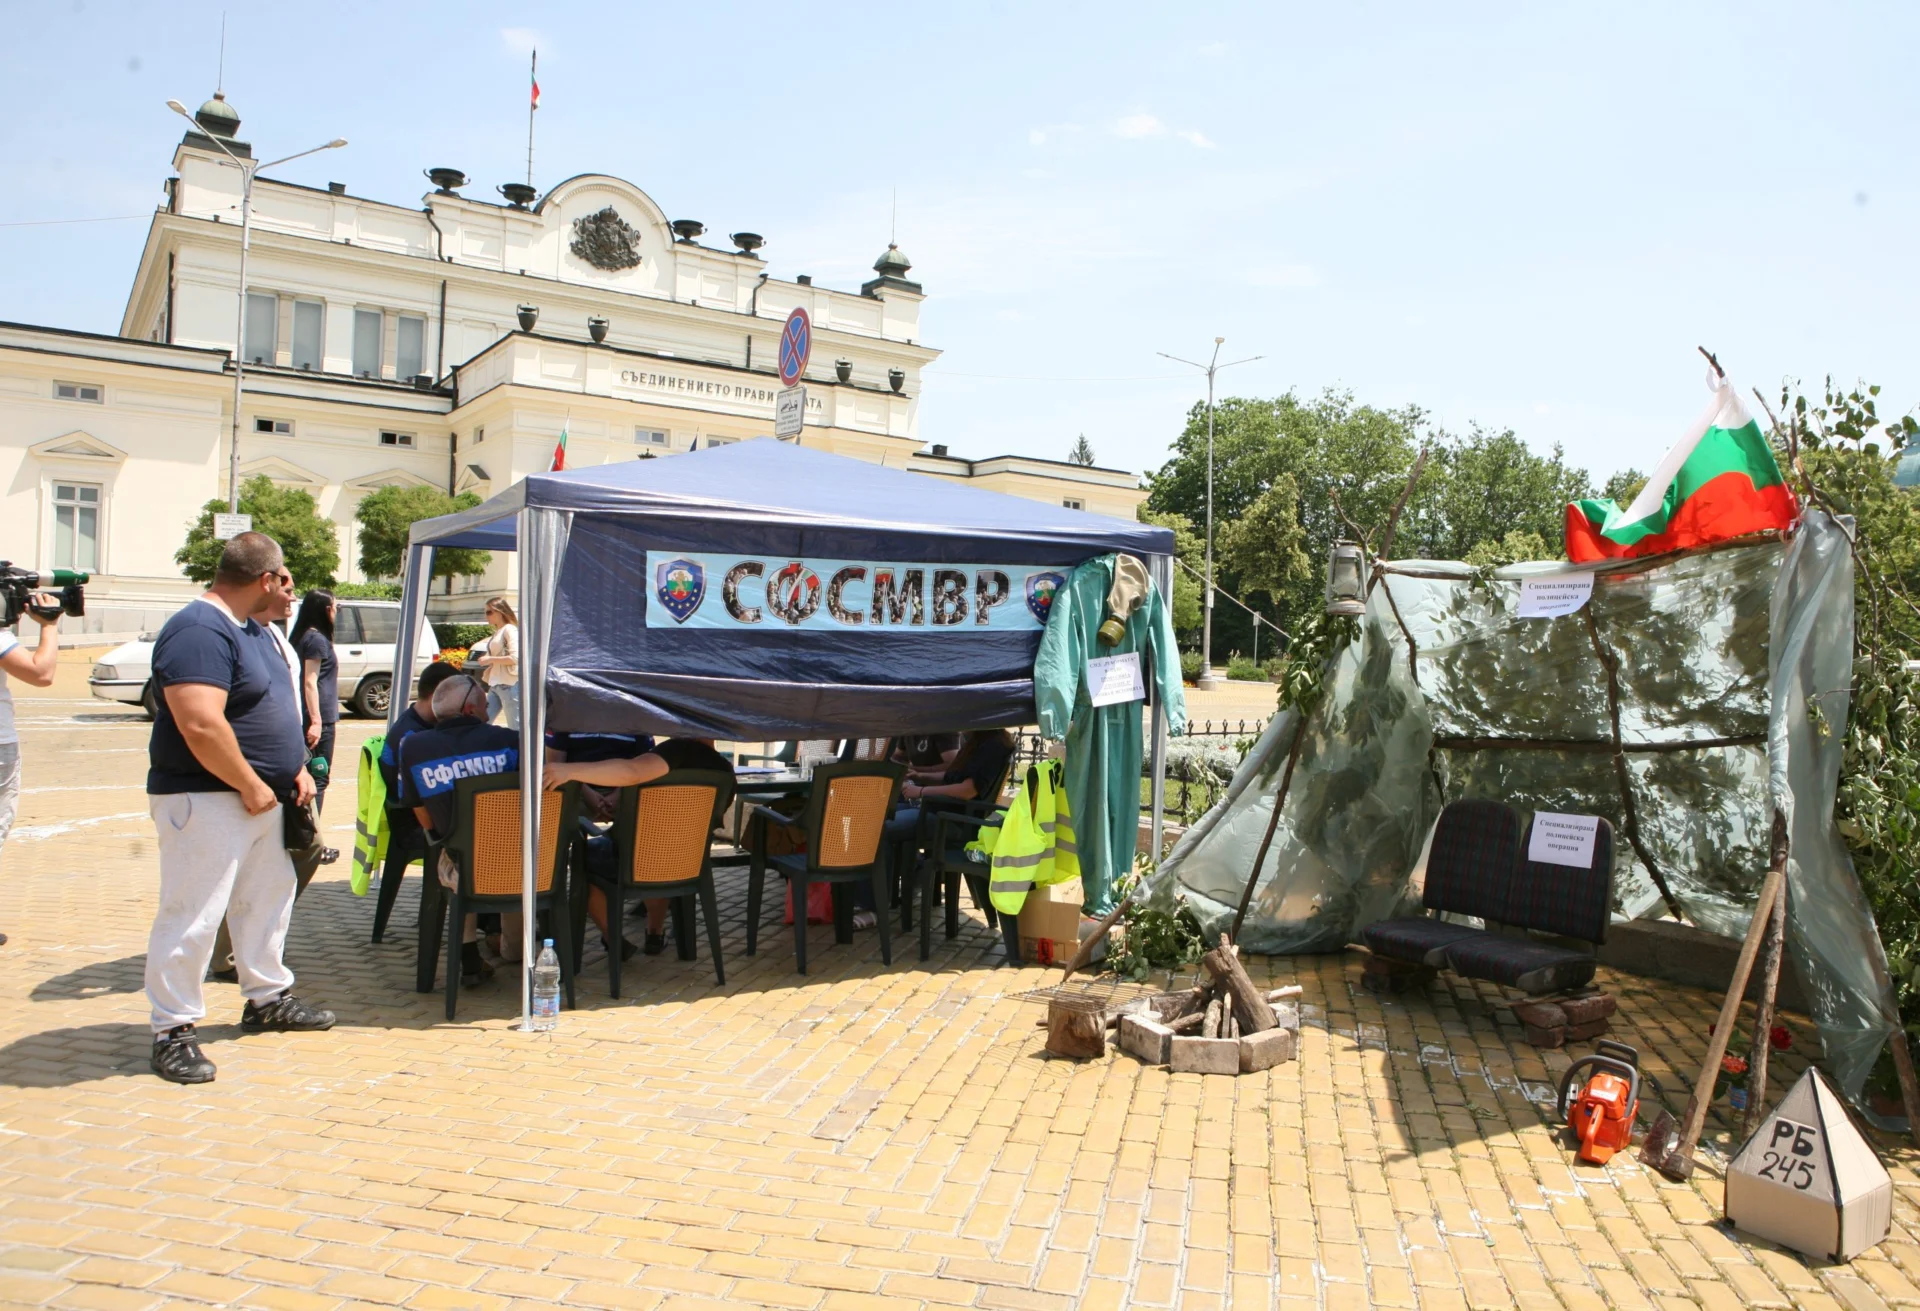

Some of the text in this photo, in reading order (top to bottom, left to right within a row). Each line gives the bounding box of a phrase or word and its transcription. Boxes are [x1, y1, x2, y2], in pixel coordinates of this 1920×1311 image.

[621, 370, 730, 395] СЪЕДИНЕНИЕТО
[735, 386, 774, 402] ПРАВИ
[721, 561, 1010, 626] СФСМВР
[1528, 582, 1591, 590] Специализирана
[422, 753, 507, 789] СФСМВР
[1540, 820, 1594, 831] Специализирана
[1548, 842, 1579, 851] операция
[1769, 1120, 1816, 1156] РБ
[1758, 1151, 1816, 1190] 245
